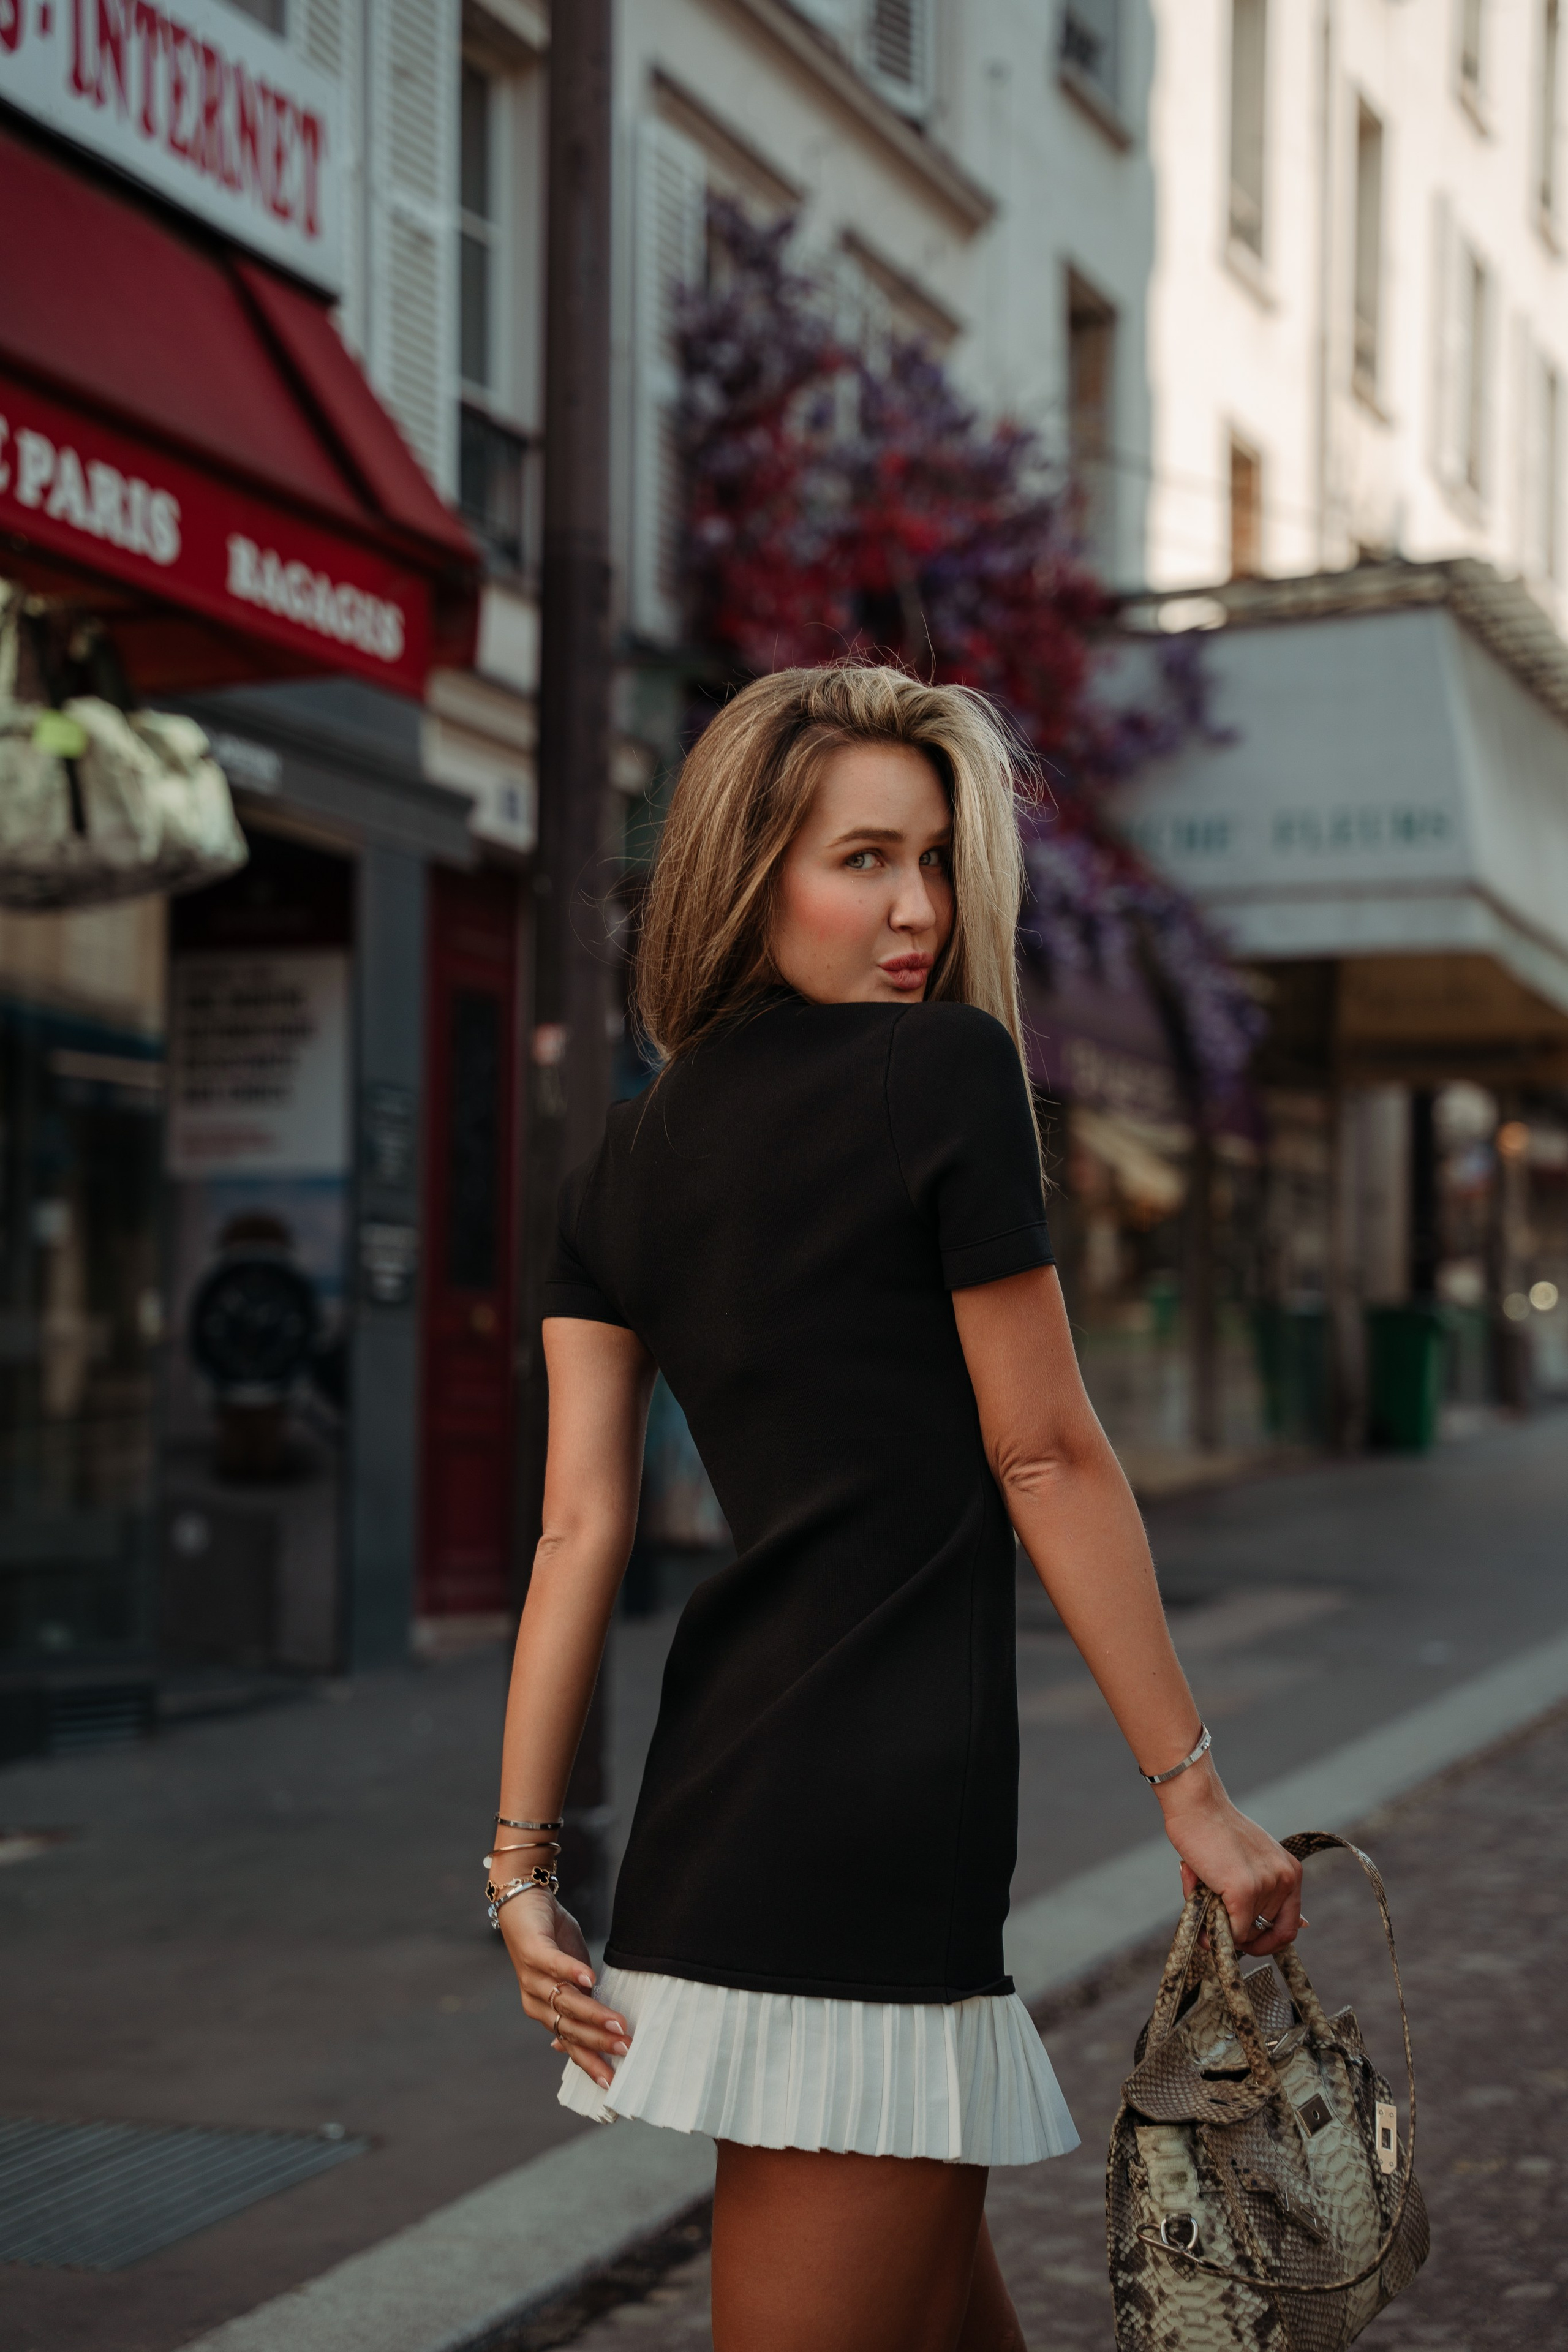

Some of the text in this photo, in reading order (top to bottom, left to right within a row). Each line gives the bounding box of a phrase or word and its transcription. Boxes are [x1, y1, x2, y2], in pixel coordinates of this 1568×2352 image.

[69, 0, 328, 240] INTERNET
[14, 425, 181, 567] PARIS
[226, 532, 405, 662] BAGAGES
